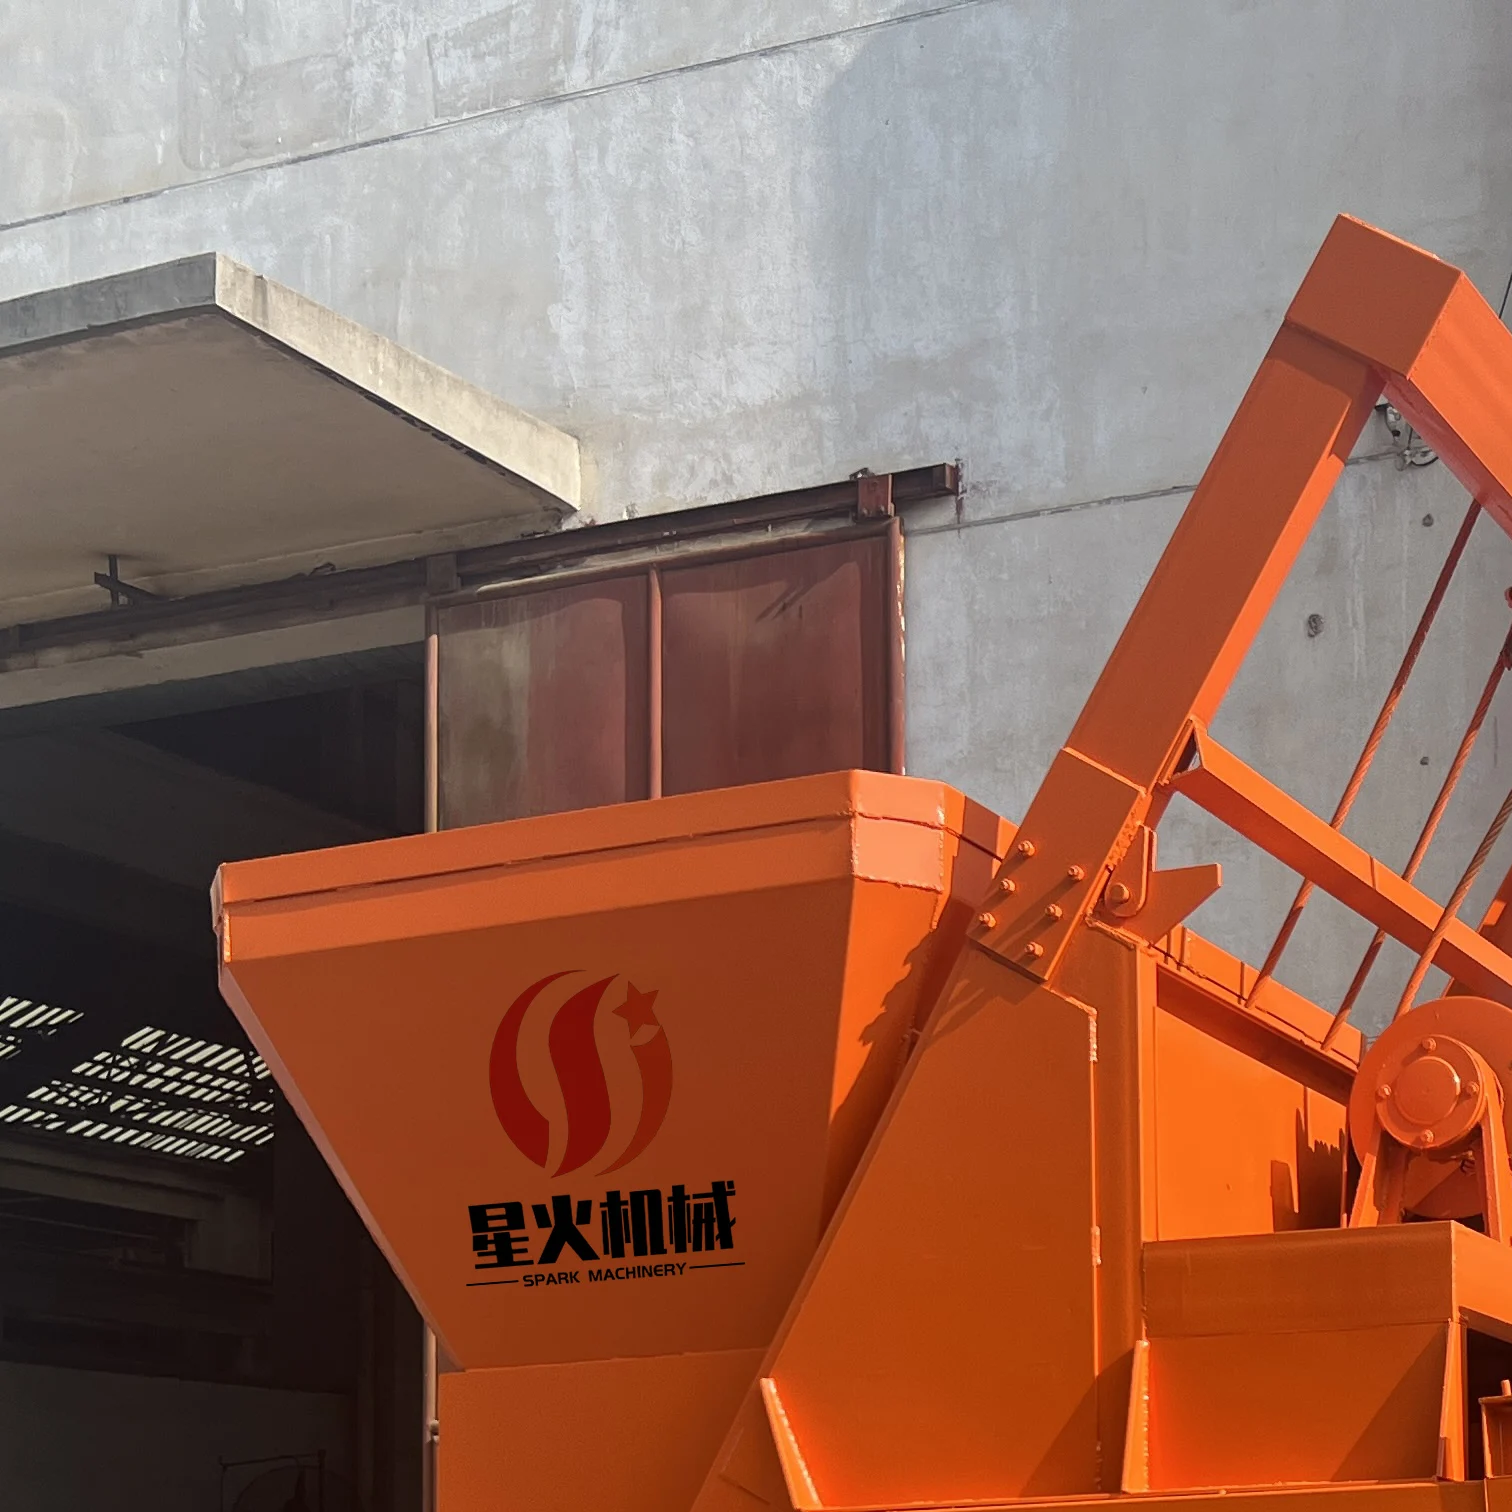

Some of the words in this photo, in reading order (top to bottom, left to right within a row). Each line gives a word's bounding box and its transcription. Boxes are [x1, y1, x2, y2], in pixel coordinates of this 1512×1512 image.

[467, 1180, 737, 1270] 星火机械
[522, 1270, 581, 1287] SPARK
[588, 1262, 687, 1282] MACHINERY
